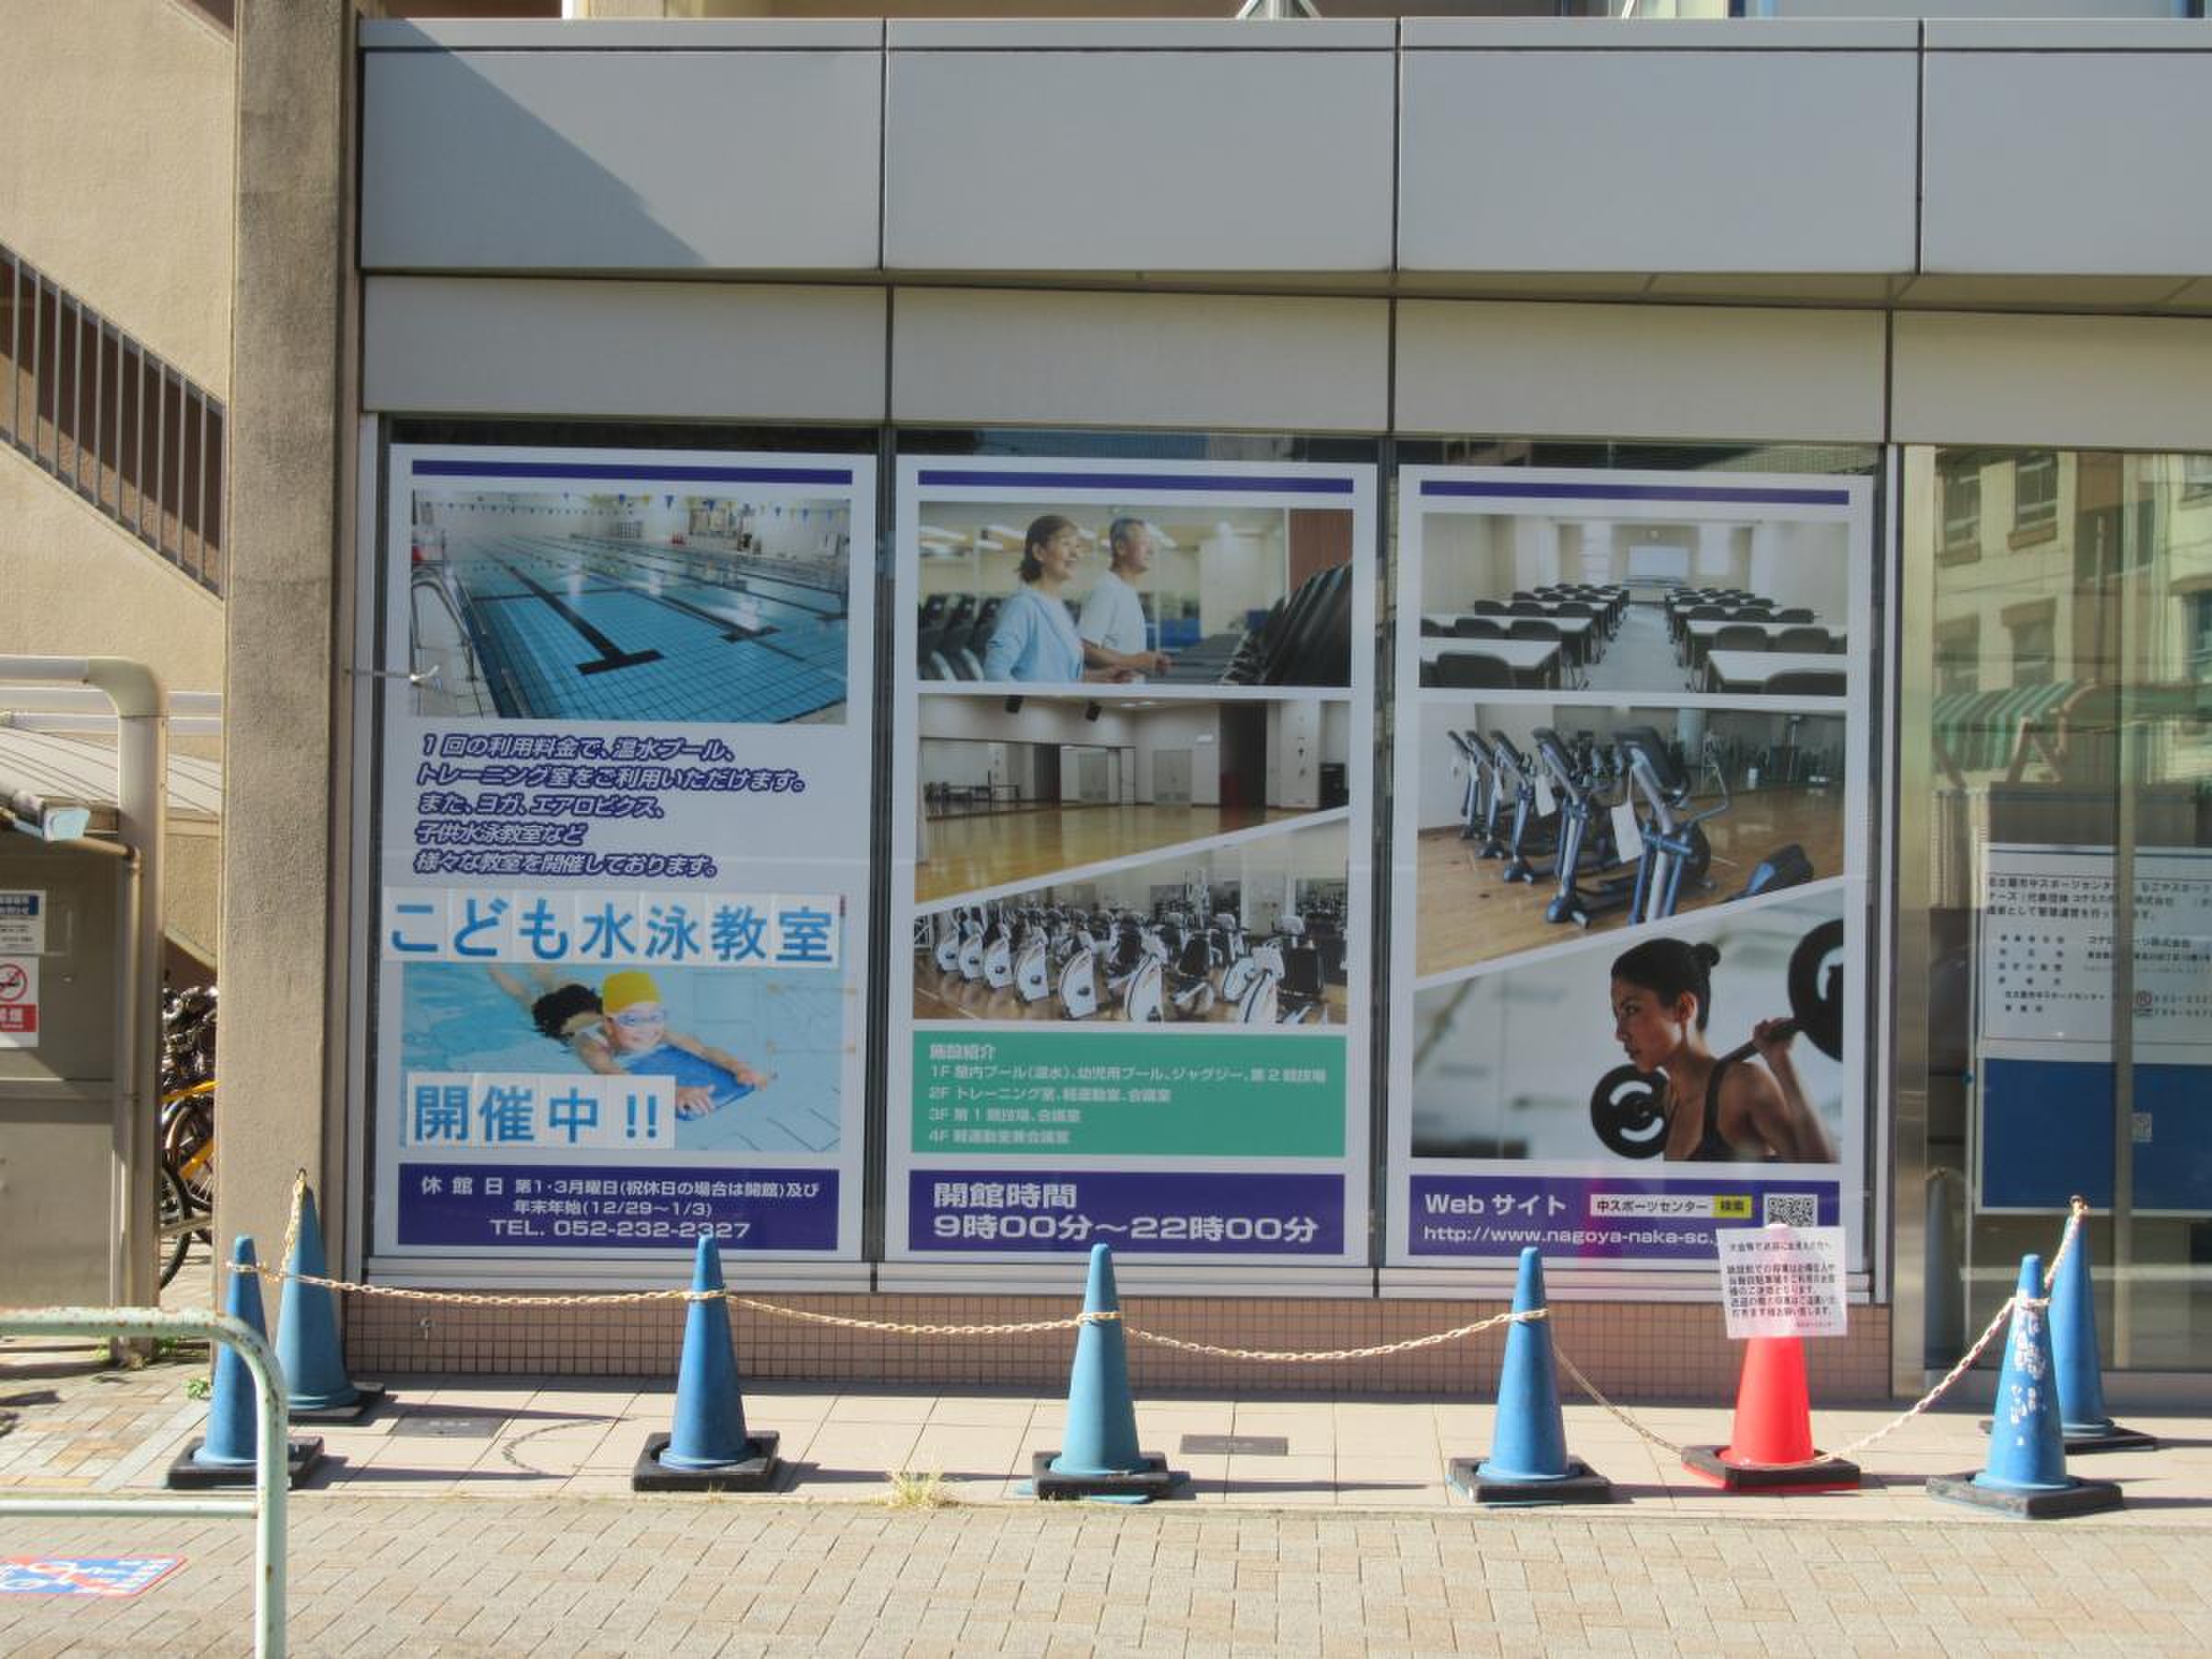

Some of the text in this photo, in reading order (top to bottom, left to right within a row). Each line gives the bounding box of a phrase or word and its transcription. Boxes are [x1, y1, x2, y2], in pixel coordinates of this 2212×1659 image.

[415, 821, 589, 847] 子供水泳教室など
[414, 850, 718, 877] 様々な教室を開催しております。
[391, 899, 834, 962] こども水泳教室
[932, 1065, 950, 1077] 1F
[929, 1087, 950, 1100] 2F
[928, 1108, 949, 1121] 3F
[928, 1129, 949, 1143] 4F
[934, 1183, 1077, 1209] 開館時間
[1425, 1194, 1567, 1216] Web サイト
[1597, 1201, 1709, 1213] 中スポーツセンター
[489, 1219, 751, 1240] TEL. 052-232-2327
[1424, 1226, 1717, 1245] http://www.nagoya-naka-sc.
